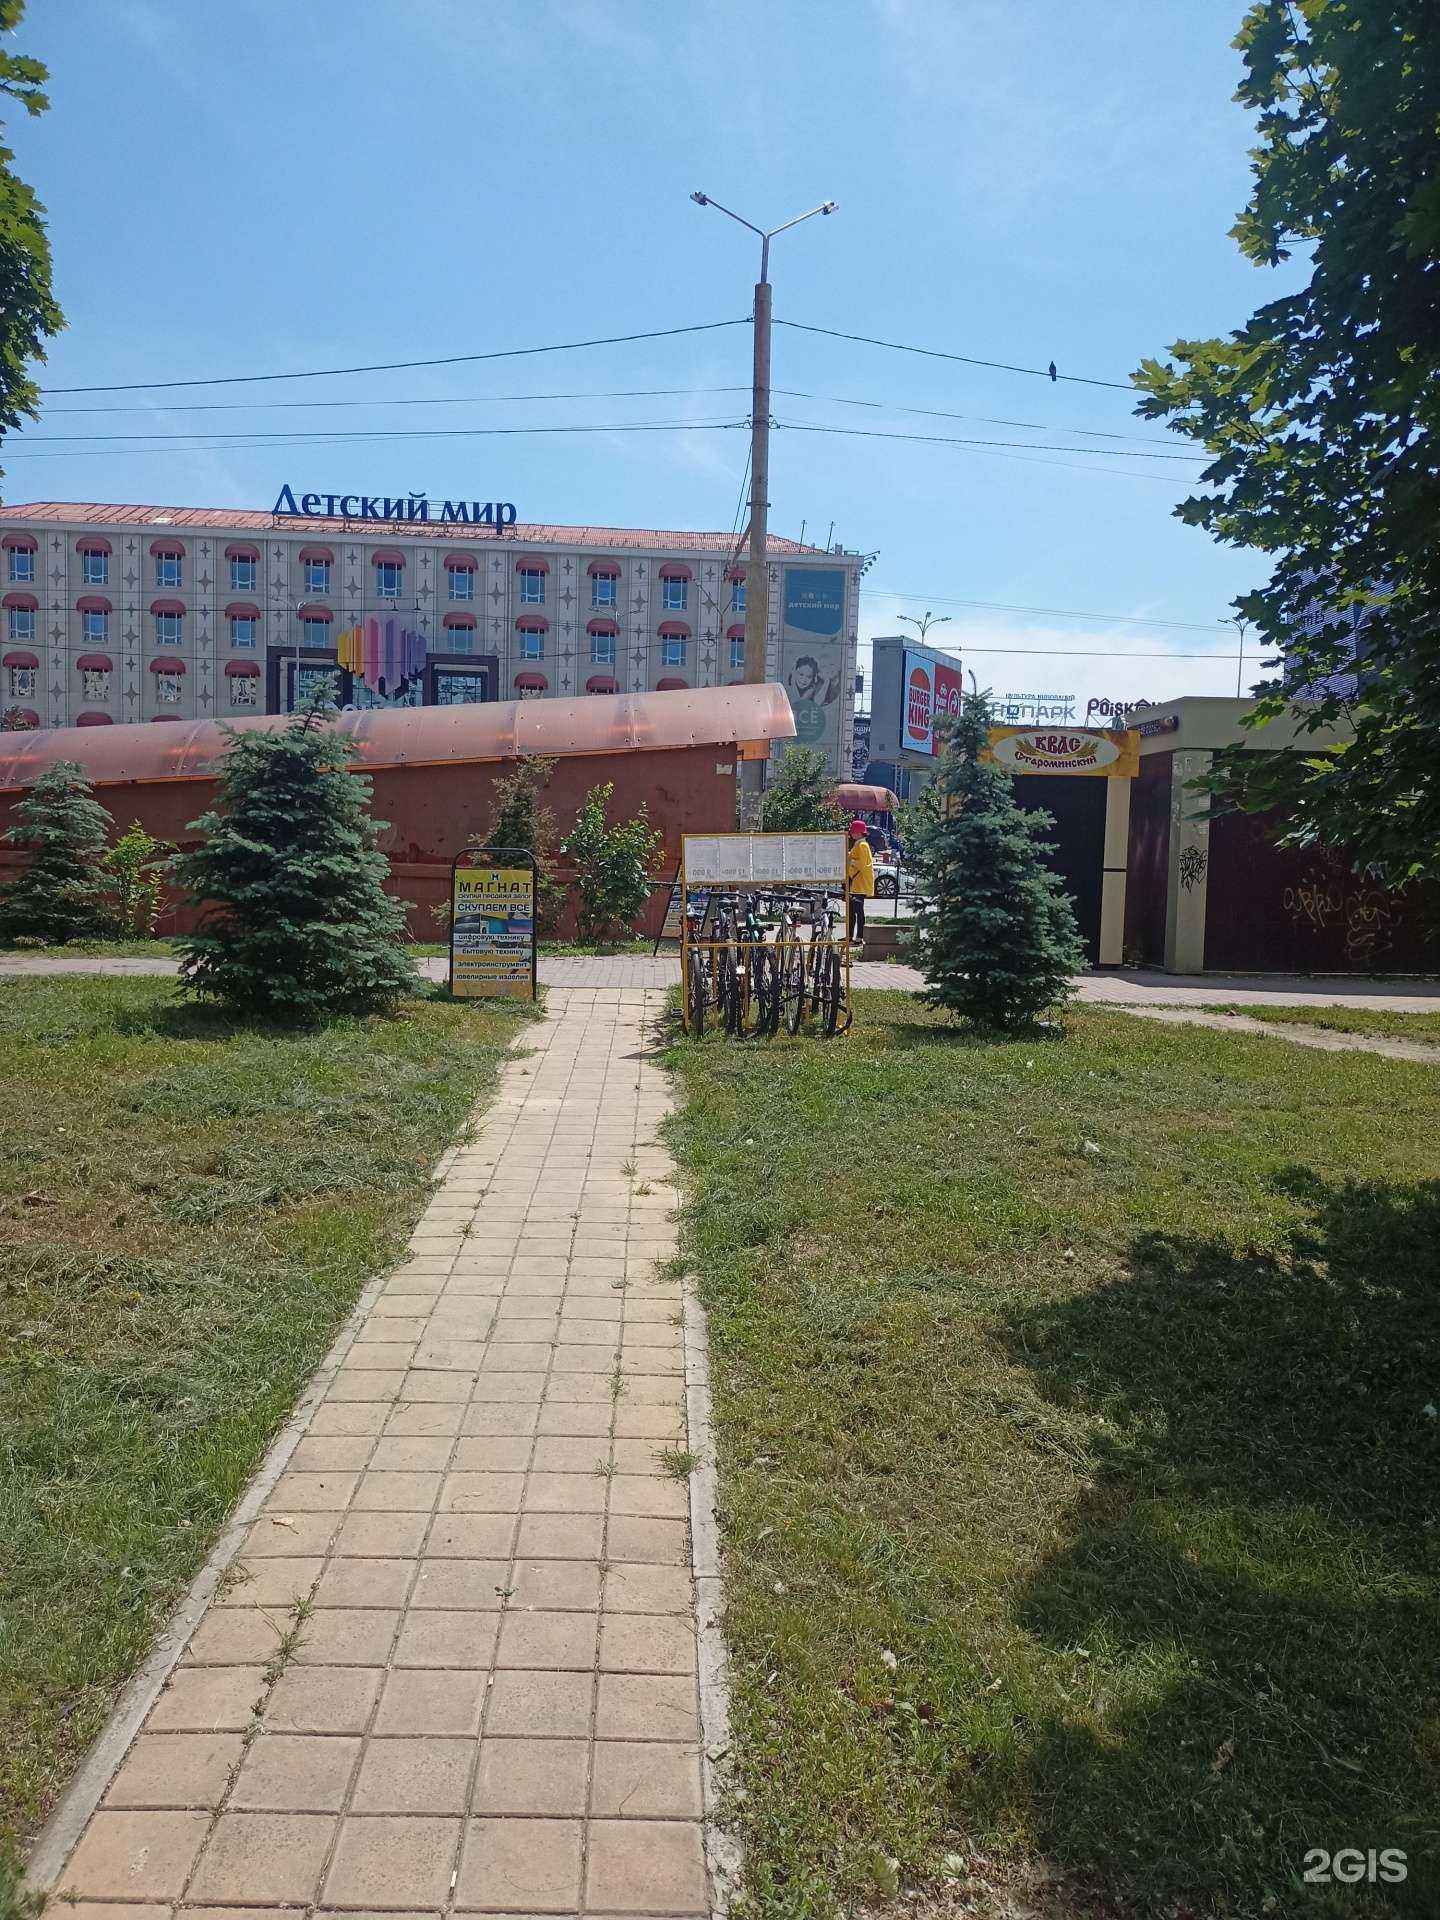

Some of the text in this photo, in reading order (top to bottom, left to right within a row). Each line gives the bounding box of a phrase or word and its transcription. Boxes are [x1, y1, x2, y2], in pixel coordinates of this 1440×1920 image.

[272, 484, 517, 535] Детский мир
[909, 688, 930, 709] BURGER
[908, 703, 930, 726] KING
[1034, 735, 1081, 754] КВАС
[1014, 751, 1097, 768] Староминский
[459, 882, 531, 892] МАГНАТ
[457, 903, 530, 912] СКУПАЕМ ВСЕ
[458, 934, 495, 942] цифровую
[462, 947, 494, 955] бытовую
